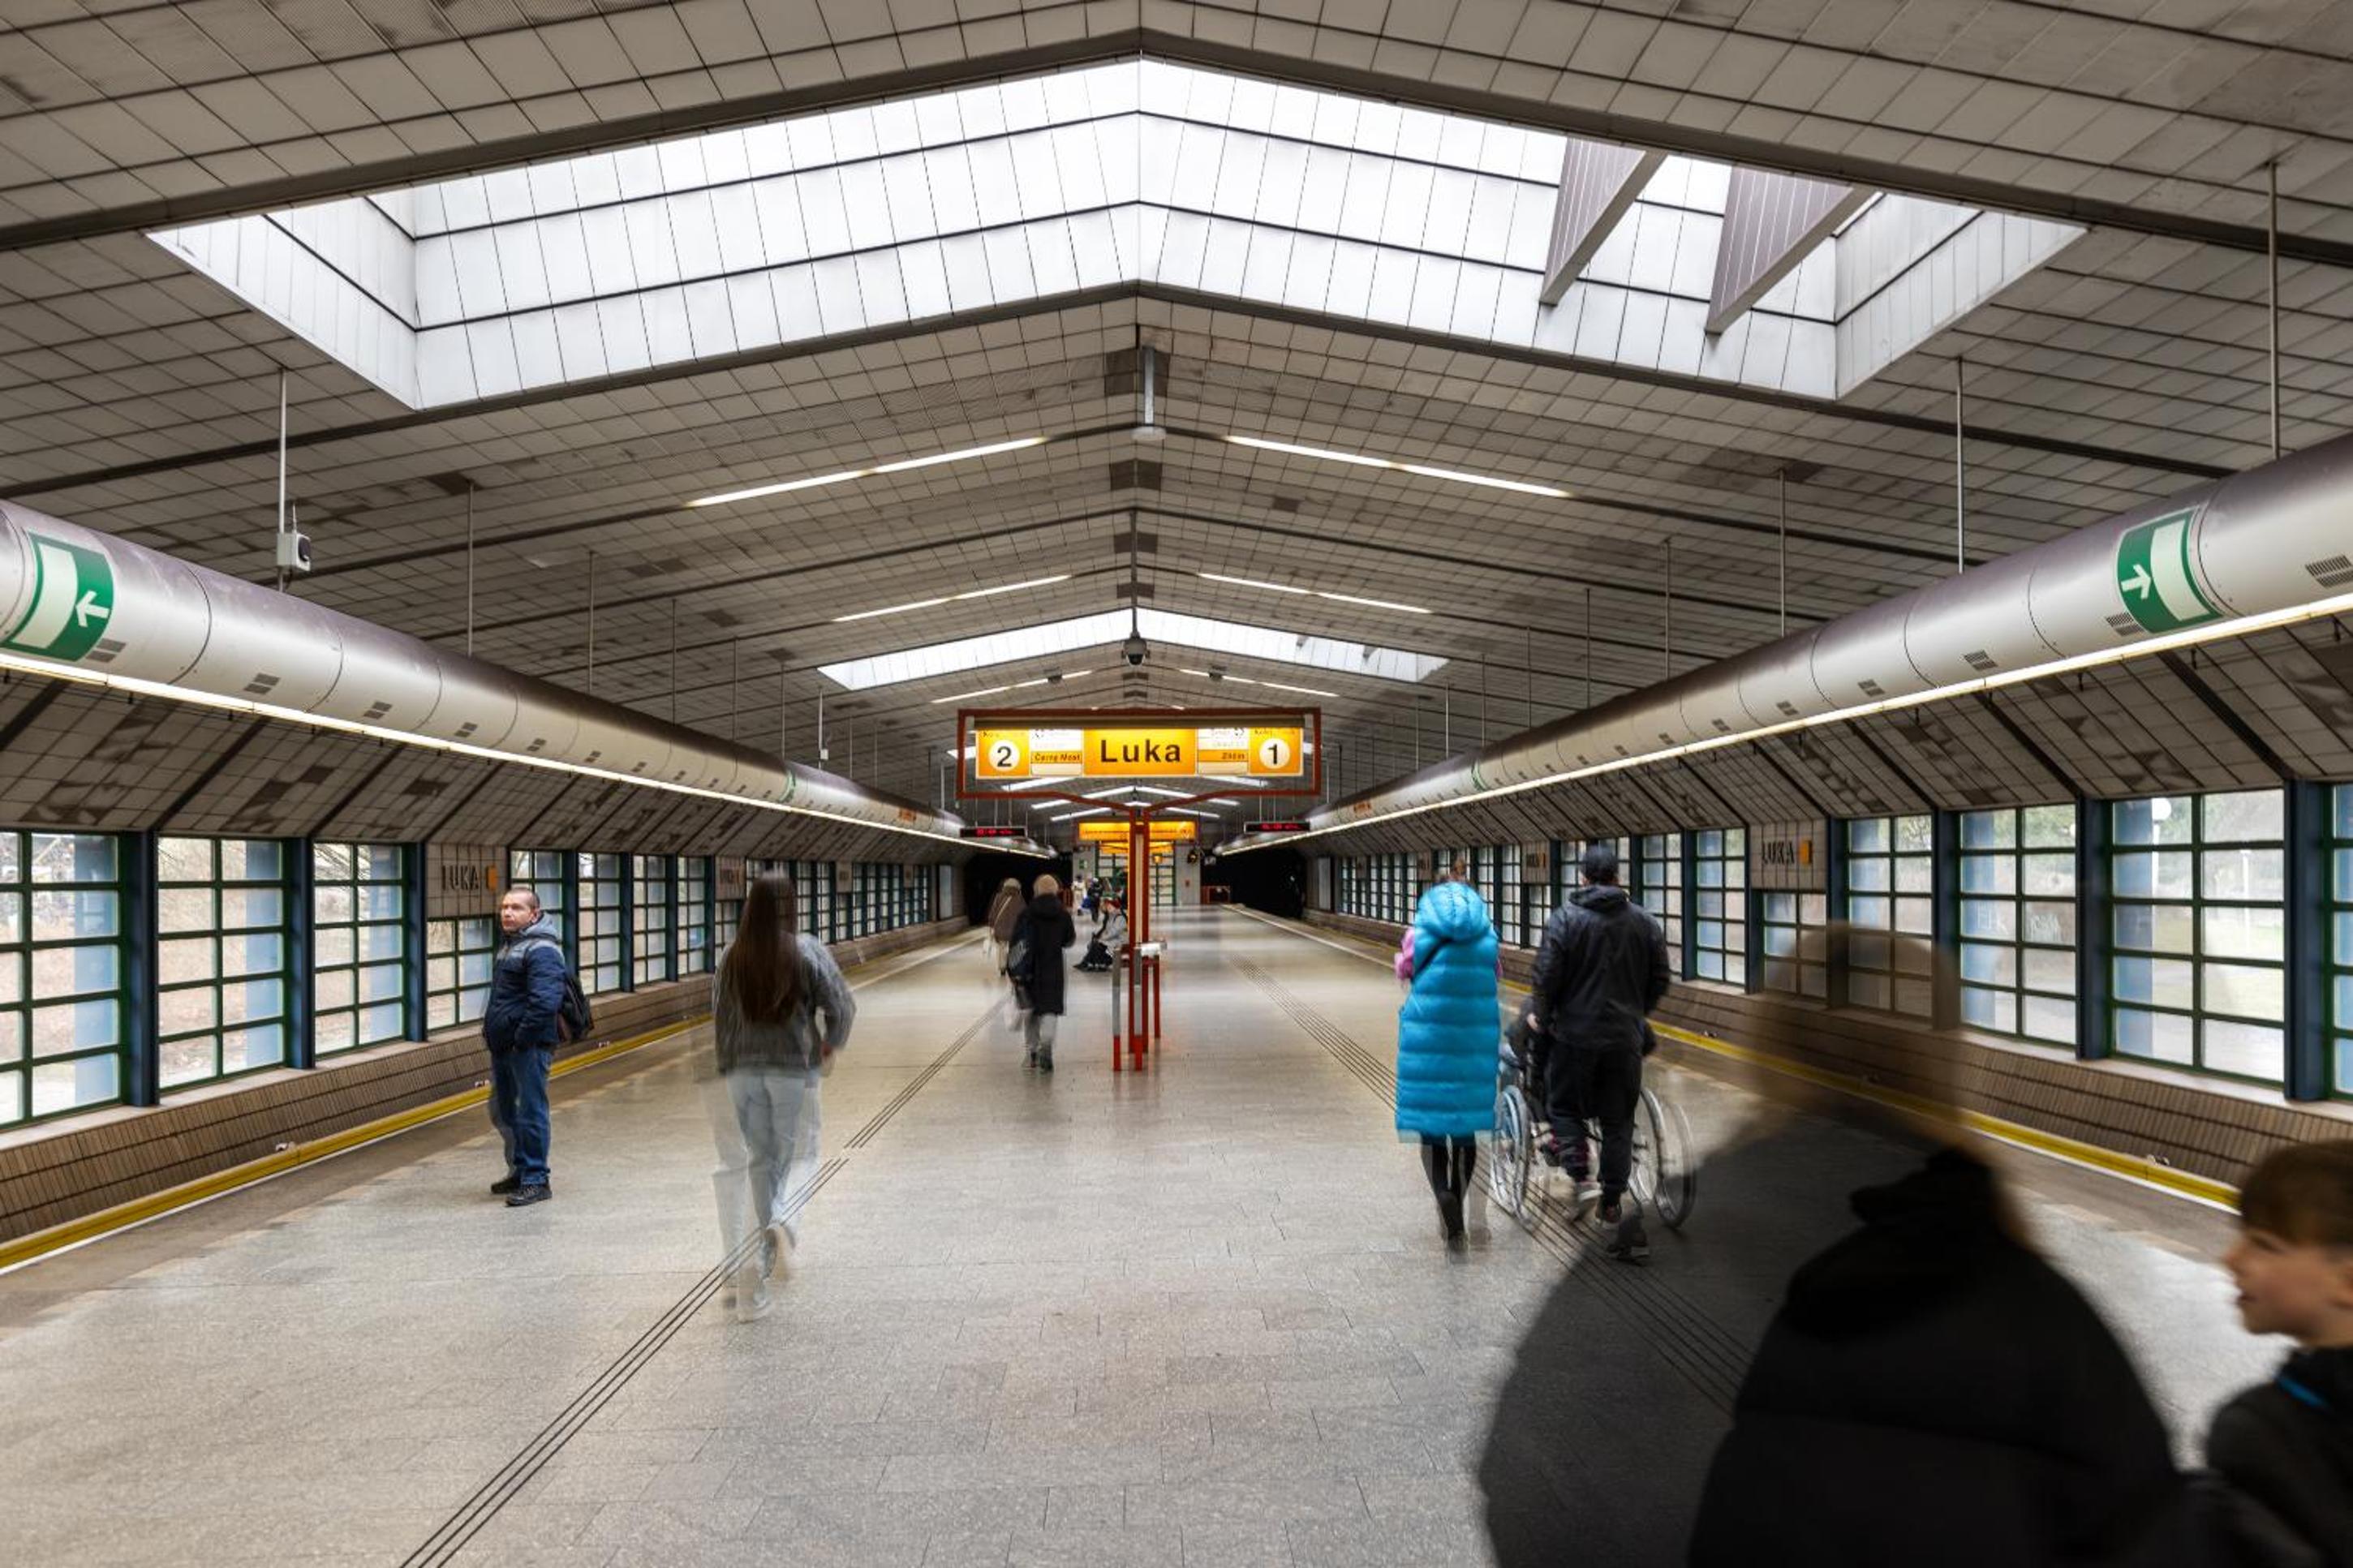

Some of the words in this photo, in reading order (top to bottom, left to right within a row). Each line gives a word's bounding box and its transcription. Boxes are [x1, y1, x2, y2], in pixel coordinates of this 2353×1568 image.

[996, 745, 1013, 767] 2
[1100, 739, 1181, 763] Luka
[1267, 743, 1278, 765] 1
[1762, 840, 1795, 866] LUKA
